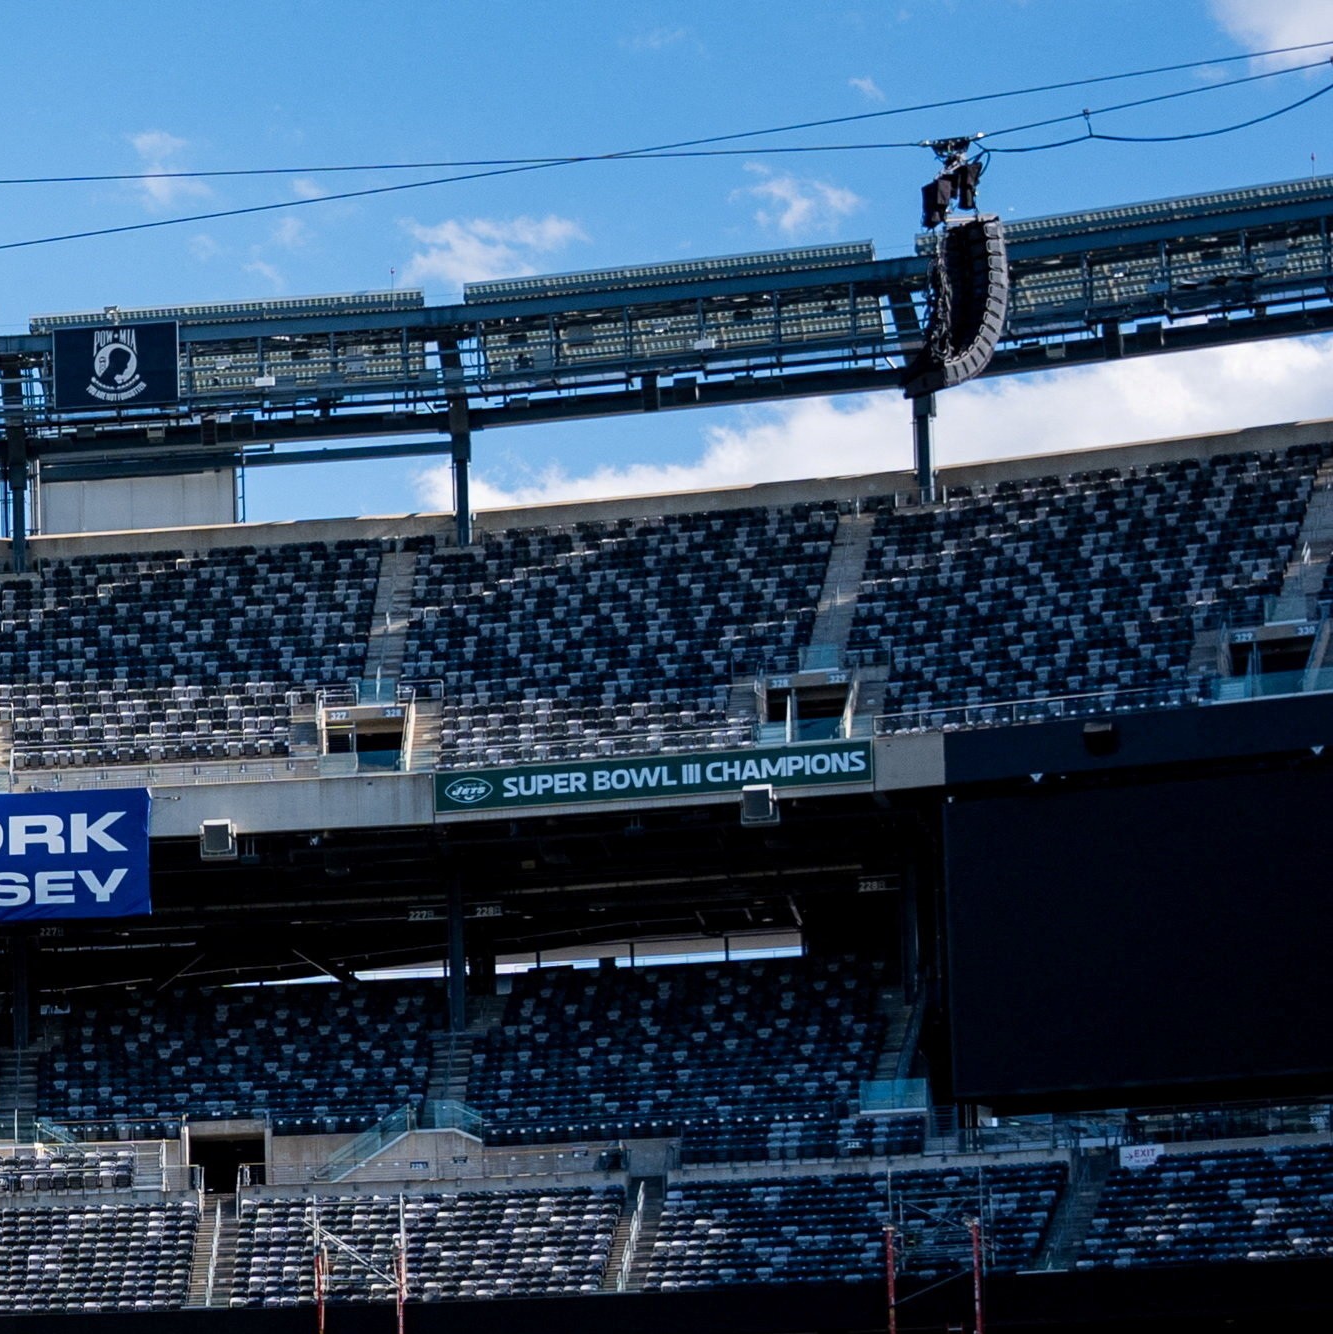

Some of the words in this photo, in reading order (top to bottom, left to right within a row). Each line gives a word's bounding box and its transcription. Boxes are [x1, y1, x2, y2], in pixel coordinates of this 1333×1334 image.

[93, 330, 114, 357] POW
[119, 328, 138, 356] MIA
[330, 711, 347, 721] 327
[502, 773, 585, 797] SUPER
[592, 768, 680, 792] BOWL
[682, 766, 700, 786] III
[704, 751, 865, 782] CHAMPIONS
[451, 786, 486, 796] JETS
[1134, 1148, 1155, 1158] EXIT
